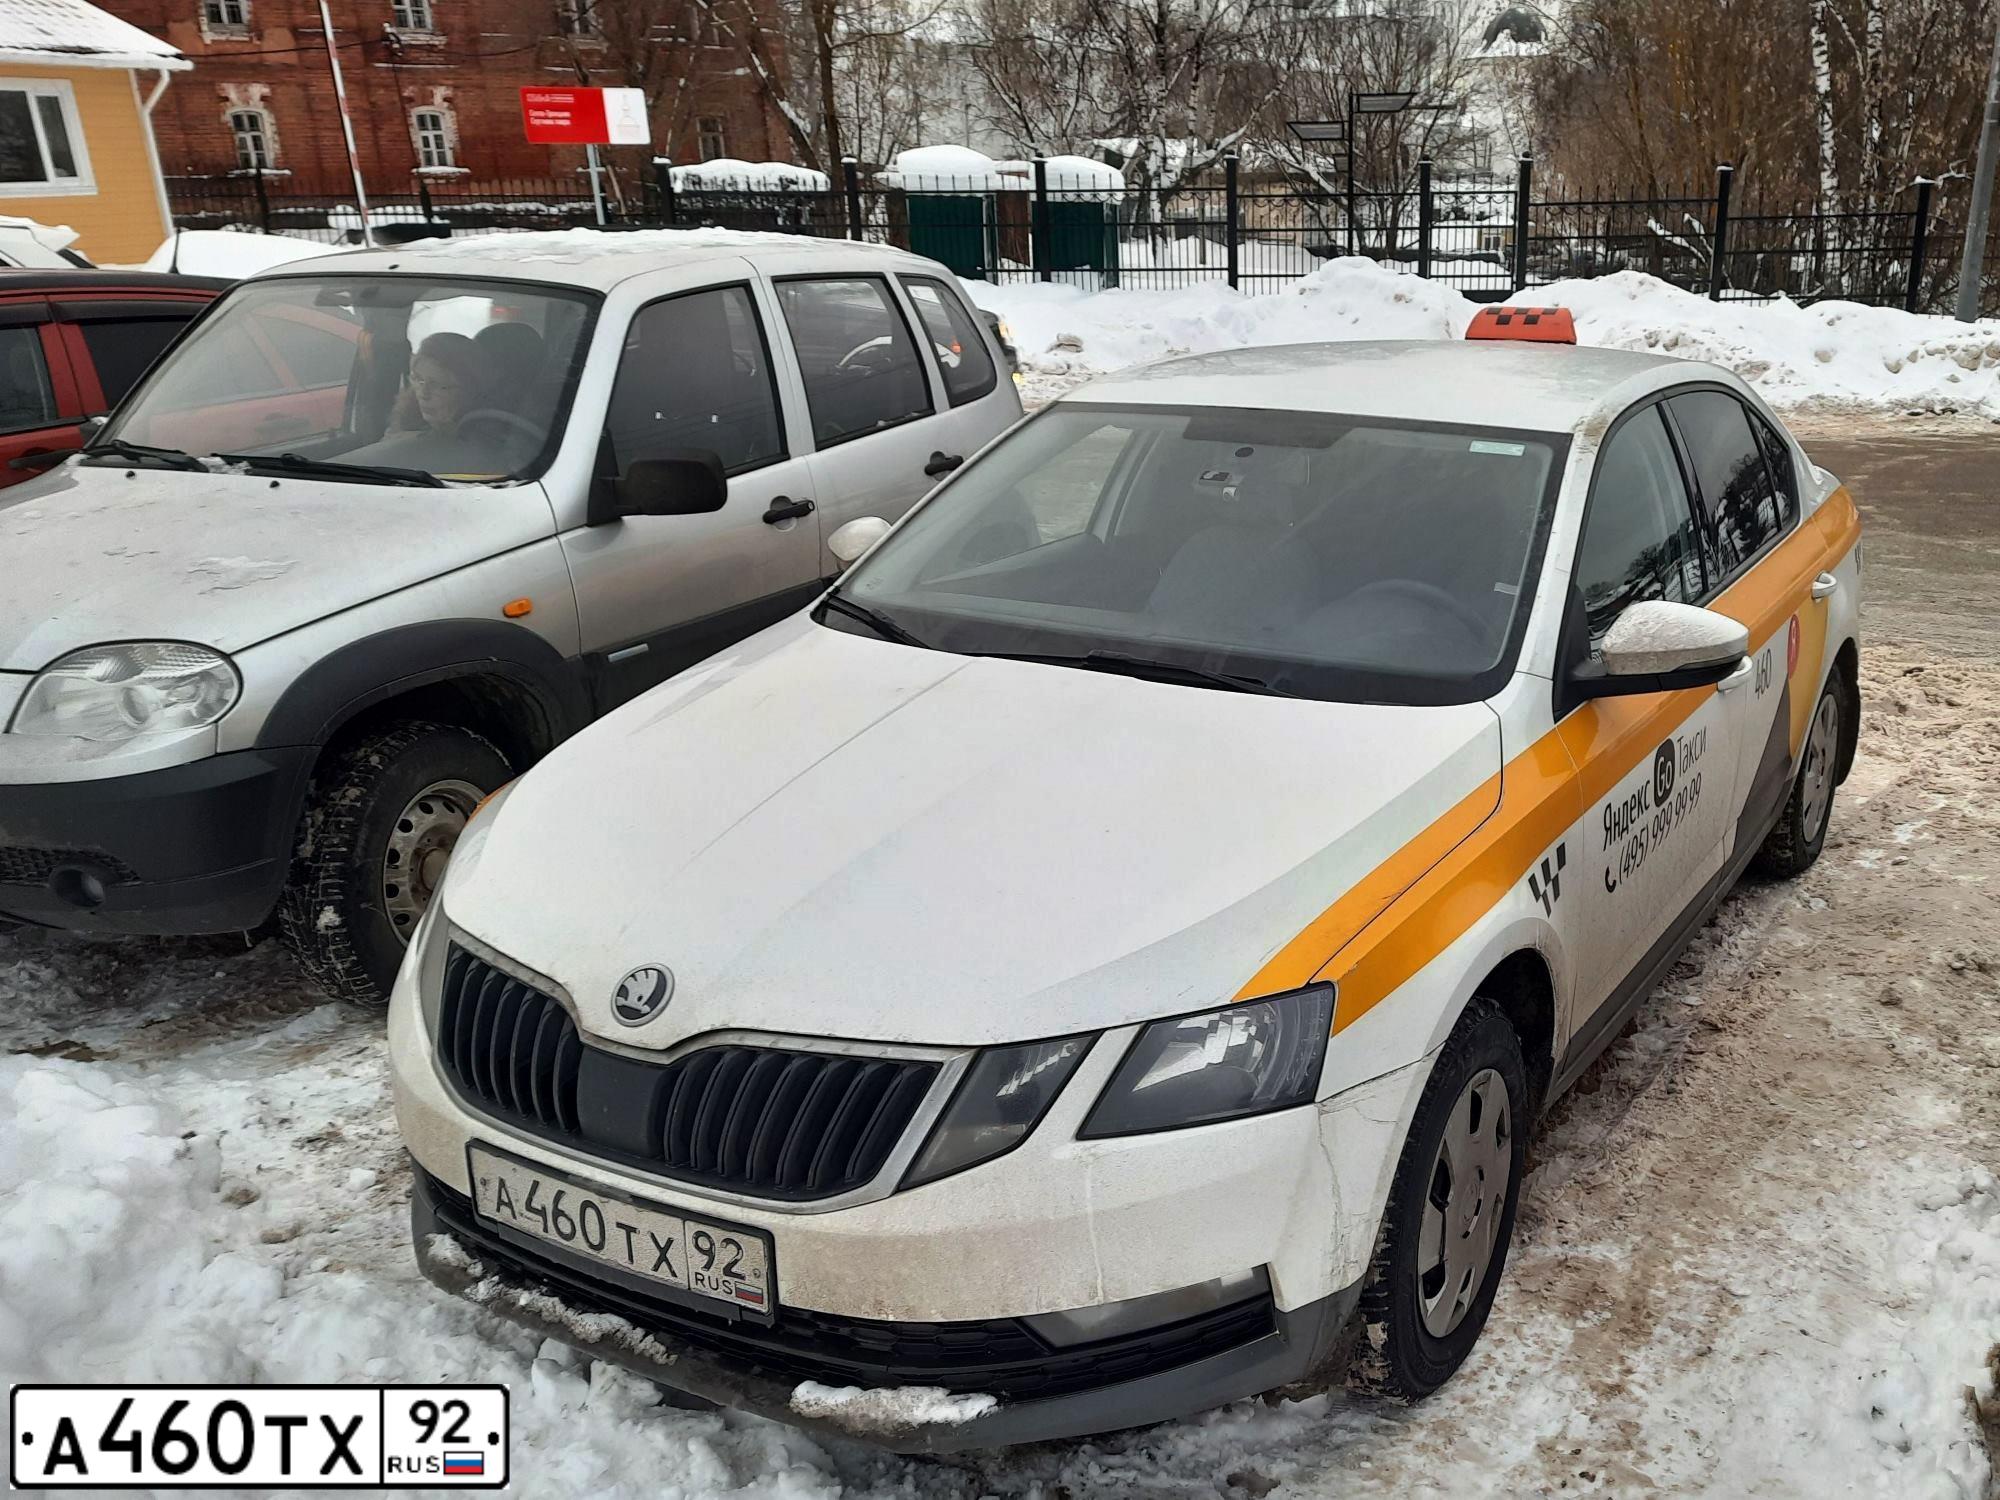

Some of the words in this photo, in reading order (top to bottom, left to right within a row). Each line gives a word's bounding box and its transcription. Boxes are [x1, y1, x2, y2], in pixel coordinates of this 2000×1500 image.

[1755, 648, 1772, 700] 460
[1603, 779, 1650, 852] Яндекс
[1677, 726, 1707, 777] Такси
[1619, 823, 1649, 885] (495)
[1652, 801, 1673, 853] 999
[1674, 786, 1688, 829] 99
[1688, 772, 1702, 814] 99
[692, 1229, 746, 1281] 92
[694, 1271, 734, 1296] RUS
